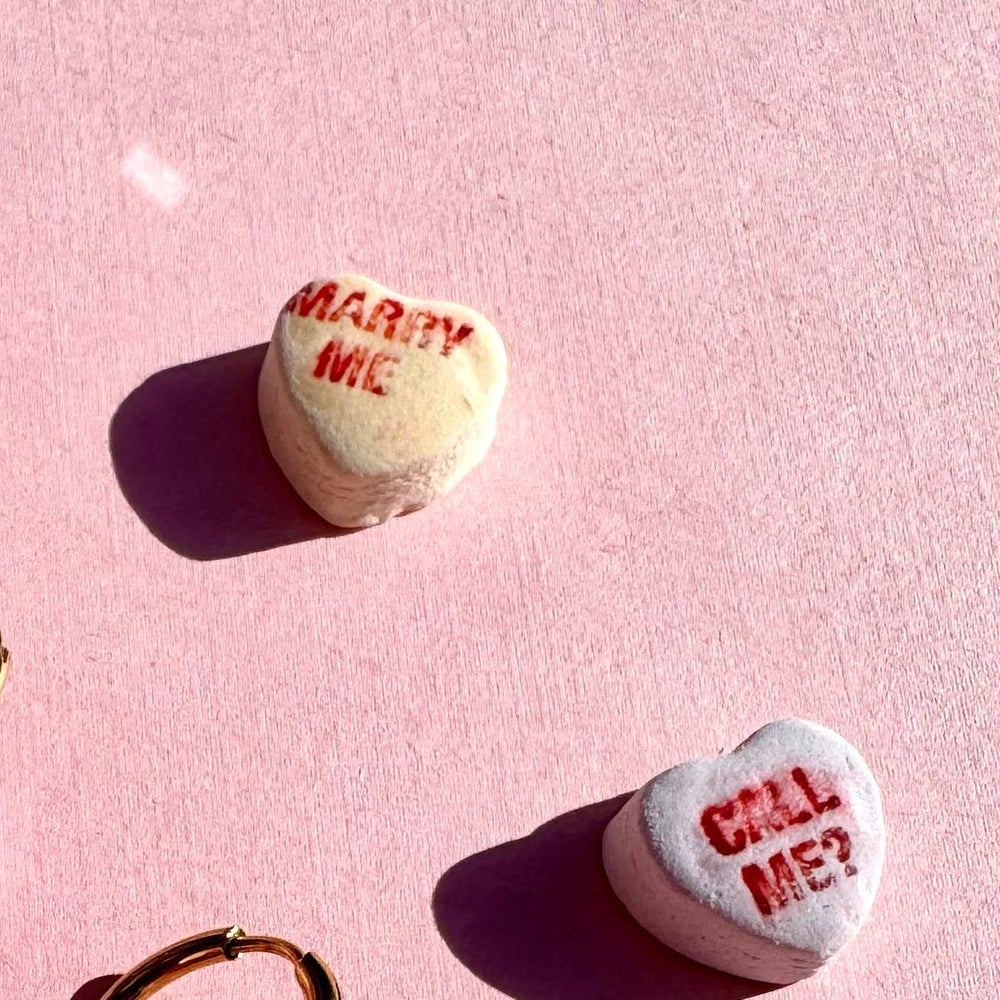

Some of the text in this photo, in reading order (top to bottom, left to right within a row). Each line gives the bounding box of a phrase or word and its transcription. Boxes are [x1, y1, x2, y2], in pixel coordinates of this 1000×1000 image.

[288, 282, 474, 358] MARRY
[312, 340, 400, 396] ME
[700, 766, 842, 856] CALL
[740, 826, 858, 916] ME?
